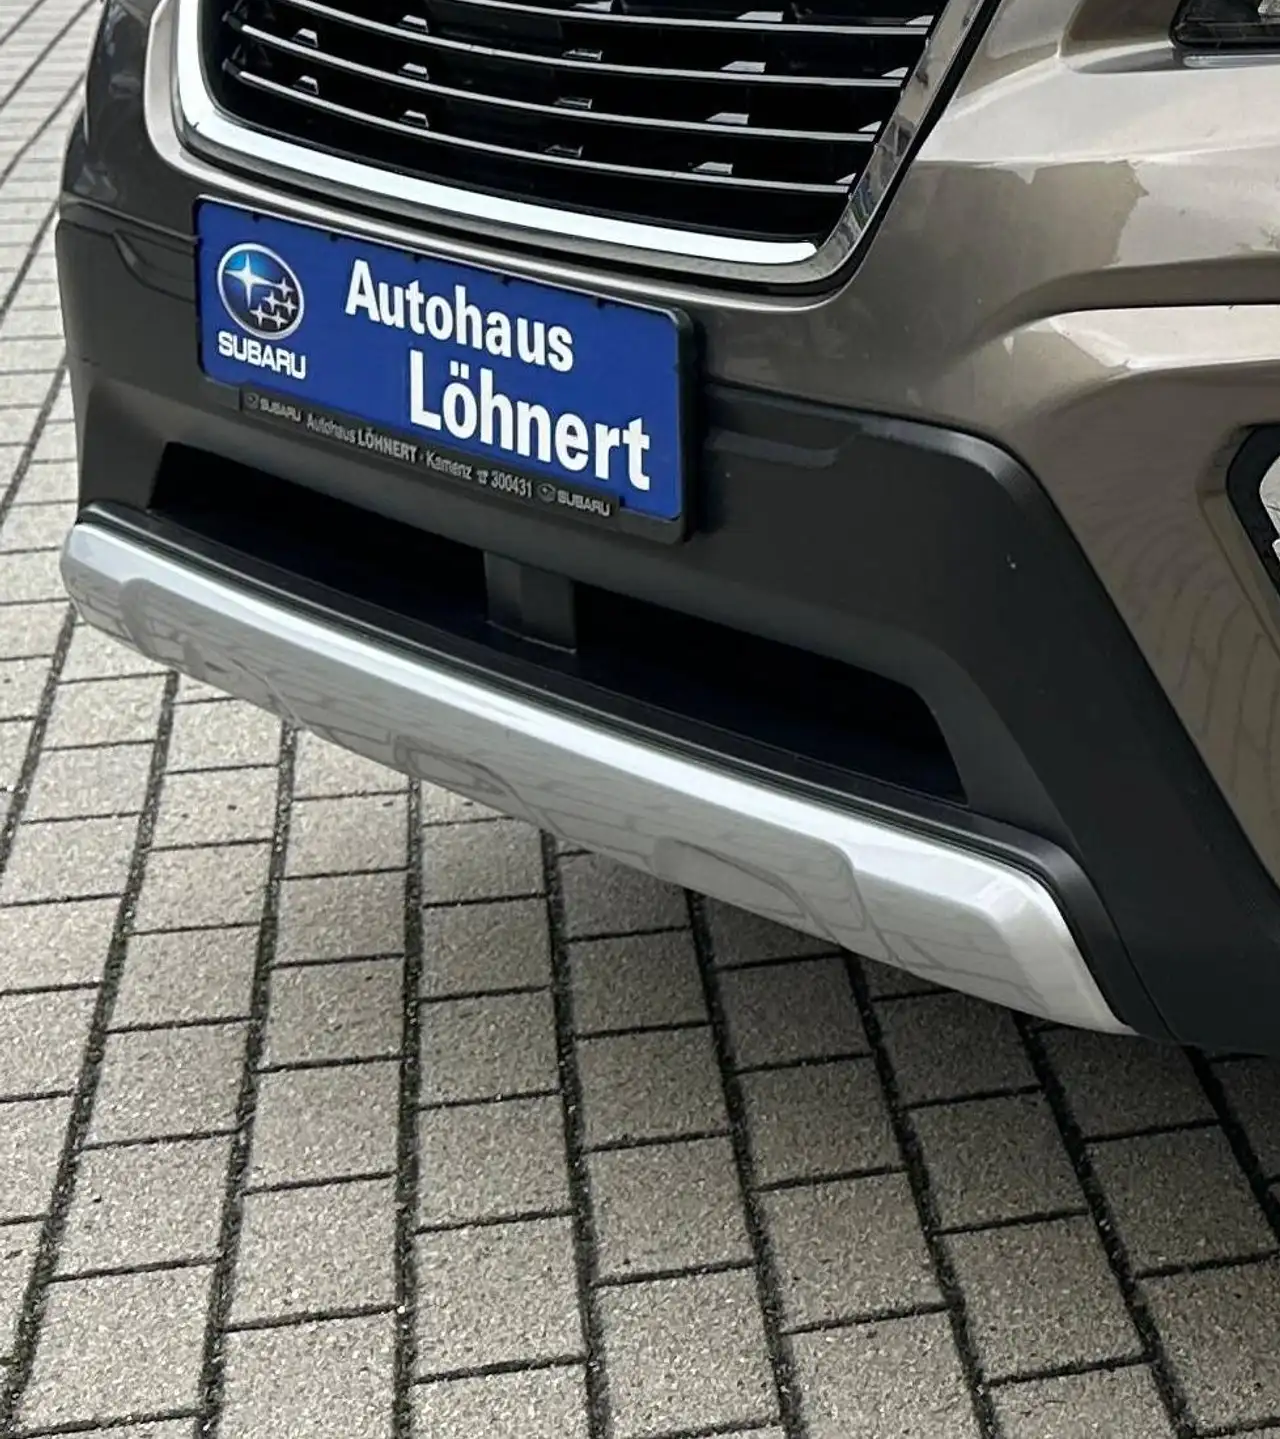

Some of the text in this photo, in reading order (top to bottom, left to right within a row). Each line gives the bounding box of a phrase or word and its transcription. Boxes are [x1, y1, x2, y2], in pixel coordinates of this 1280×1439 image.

[218, 330, 307, 380] SUBARU
[345, 258, 574, 372] Autohaus
[260, 397, 611, 517] SUBARU Autohaus LÖHNERT Kamenz 300431 SUBARU
[409, 350, 651, 491] Löhnert
